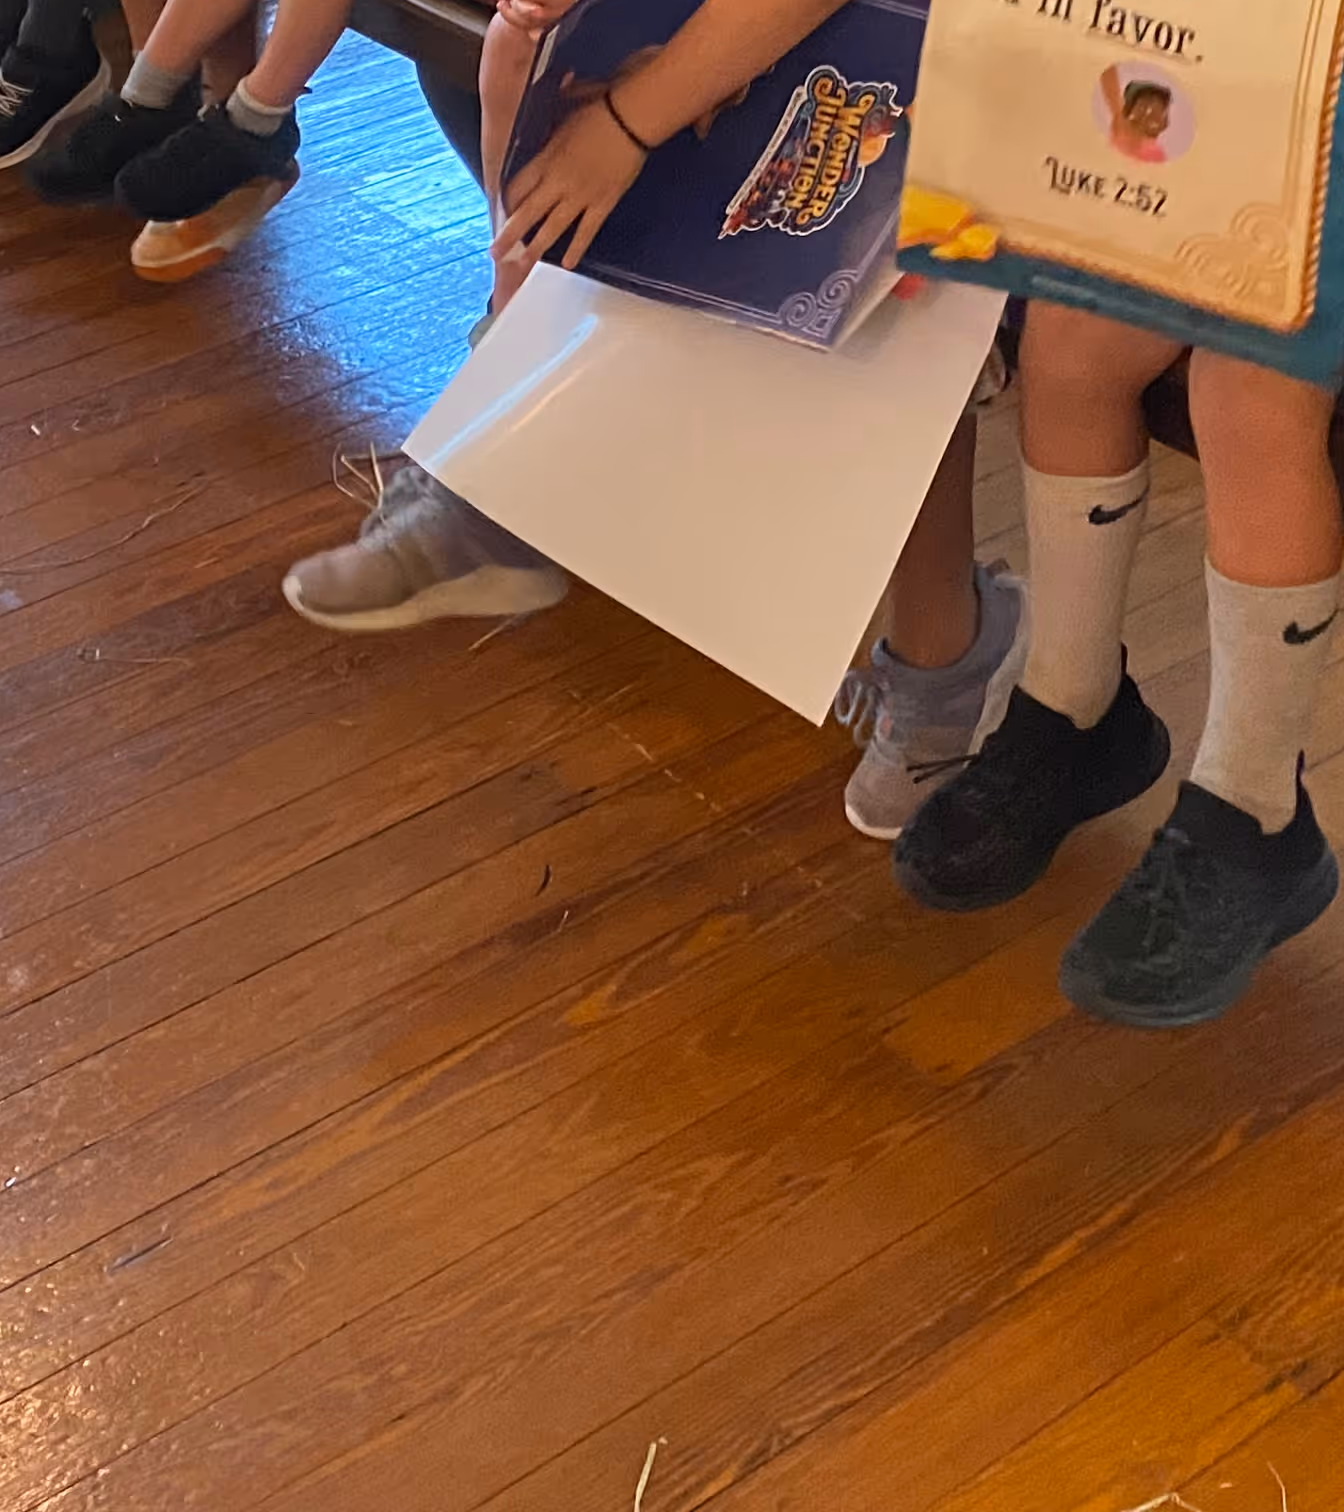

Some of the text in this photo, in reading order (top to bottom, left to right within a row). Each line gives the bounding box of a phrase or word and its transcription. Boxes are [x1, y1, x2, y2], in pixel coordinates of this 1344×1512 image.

[784, 76, 848, 210] JUNCTION
[796, 92, 876, 226] WONDER
[1114, 176, 1169, 218] 2:52
